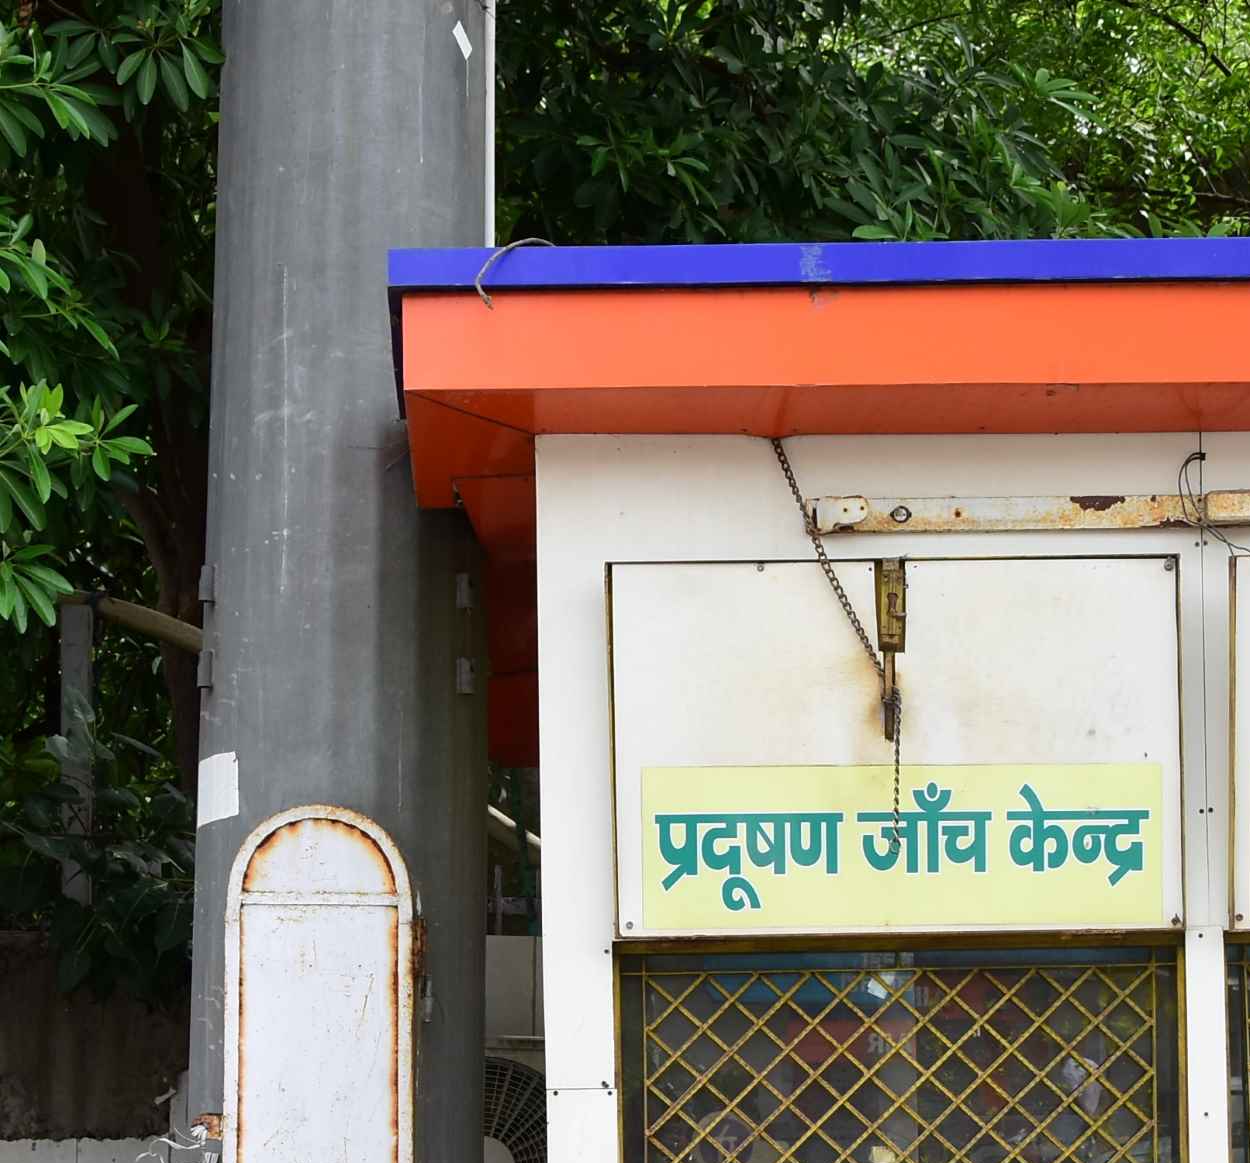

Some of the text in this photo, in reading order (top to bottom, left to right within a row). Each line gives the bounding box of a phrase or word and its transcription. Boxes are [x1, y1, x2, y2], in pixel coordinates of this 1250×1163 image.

[655, 782, 1149, 911] प्रदूषण जाँच केन्द्र
